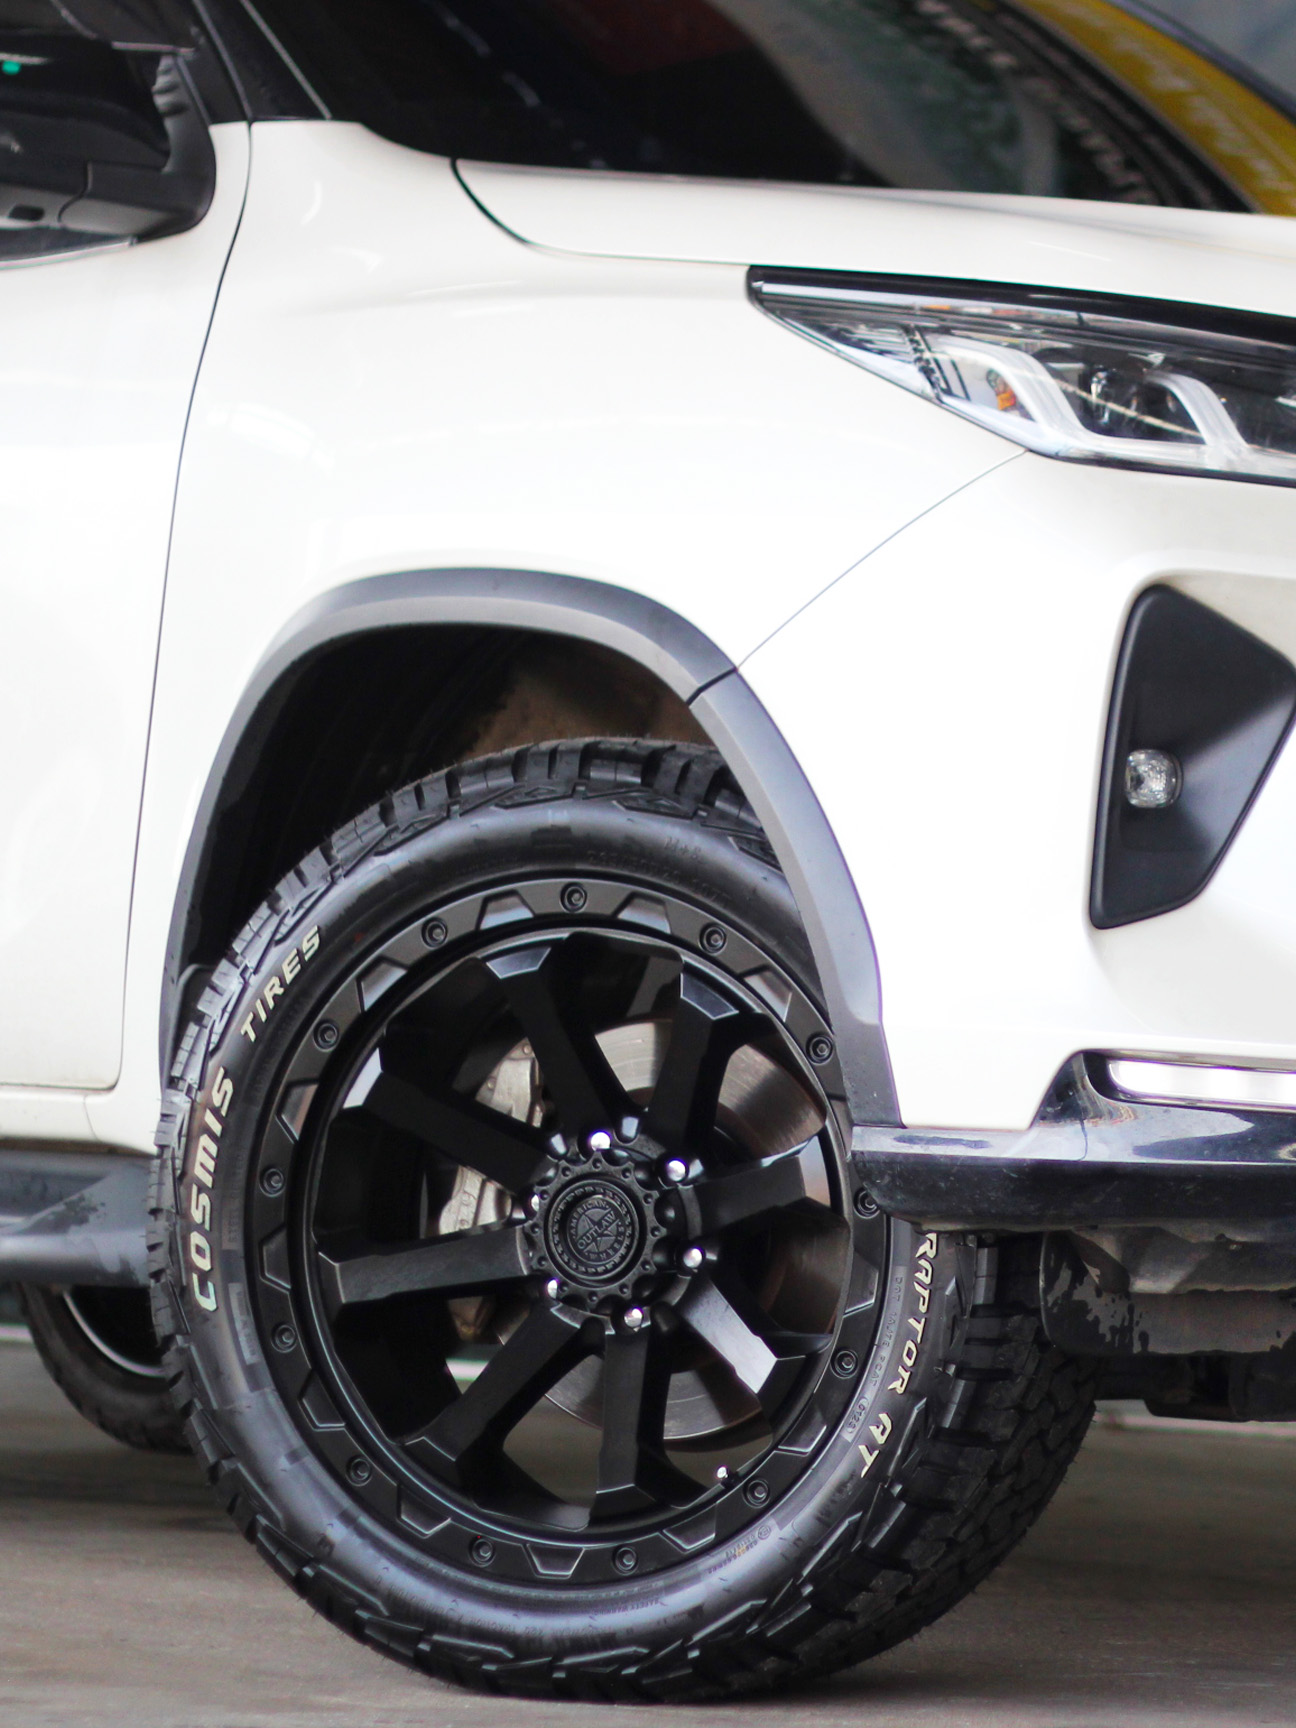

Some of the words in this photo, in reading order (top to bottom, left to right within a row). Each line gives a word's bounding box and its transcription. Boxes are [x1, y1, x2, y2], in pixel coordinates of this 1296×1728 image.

[190, 1066, 234, 1312] COSMIS
[240, 924, 321, 1043] TIRES
[577, 1210, 616, 1249] OUTLAW
[887, 1232, 937, 1394] RAPTOR
